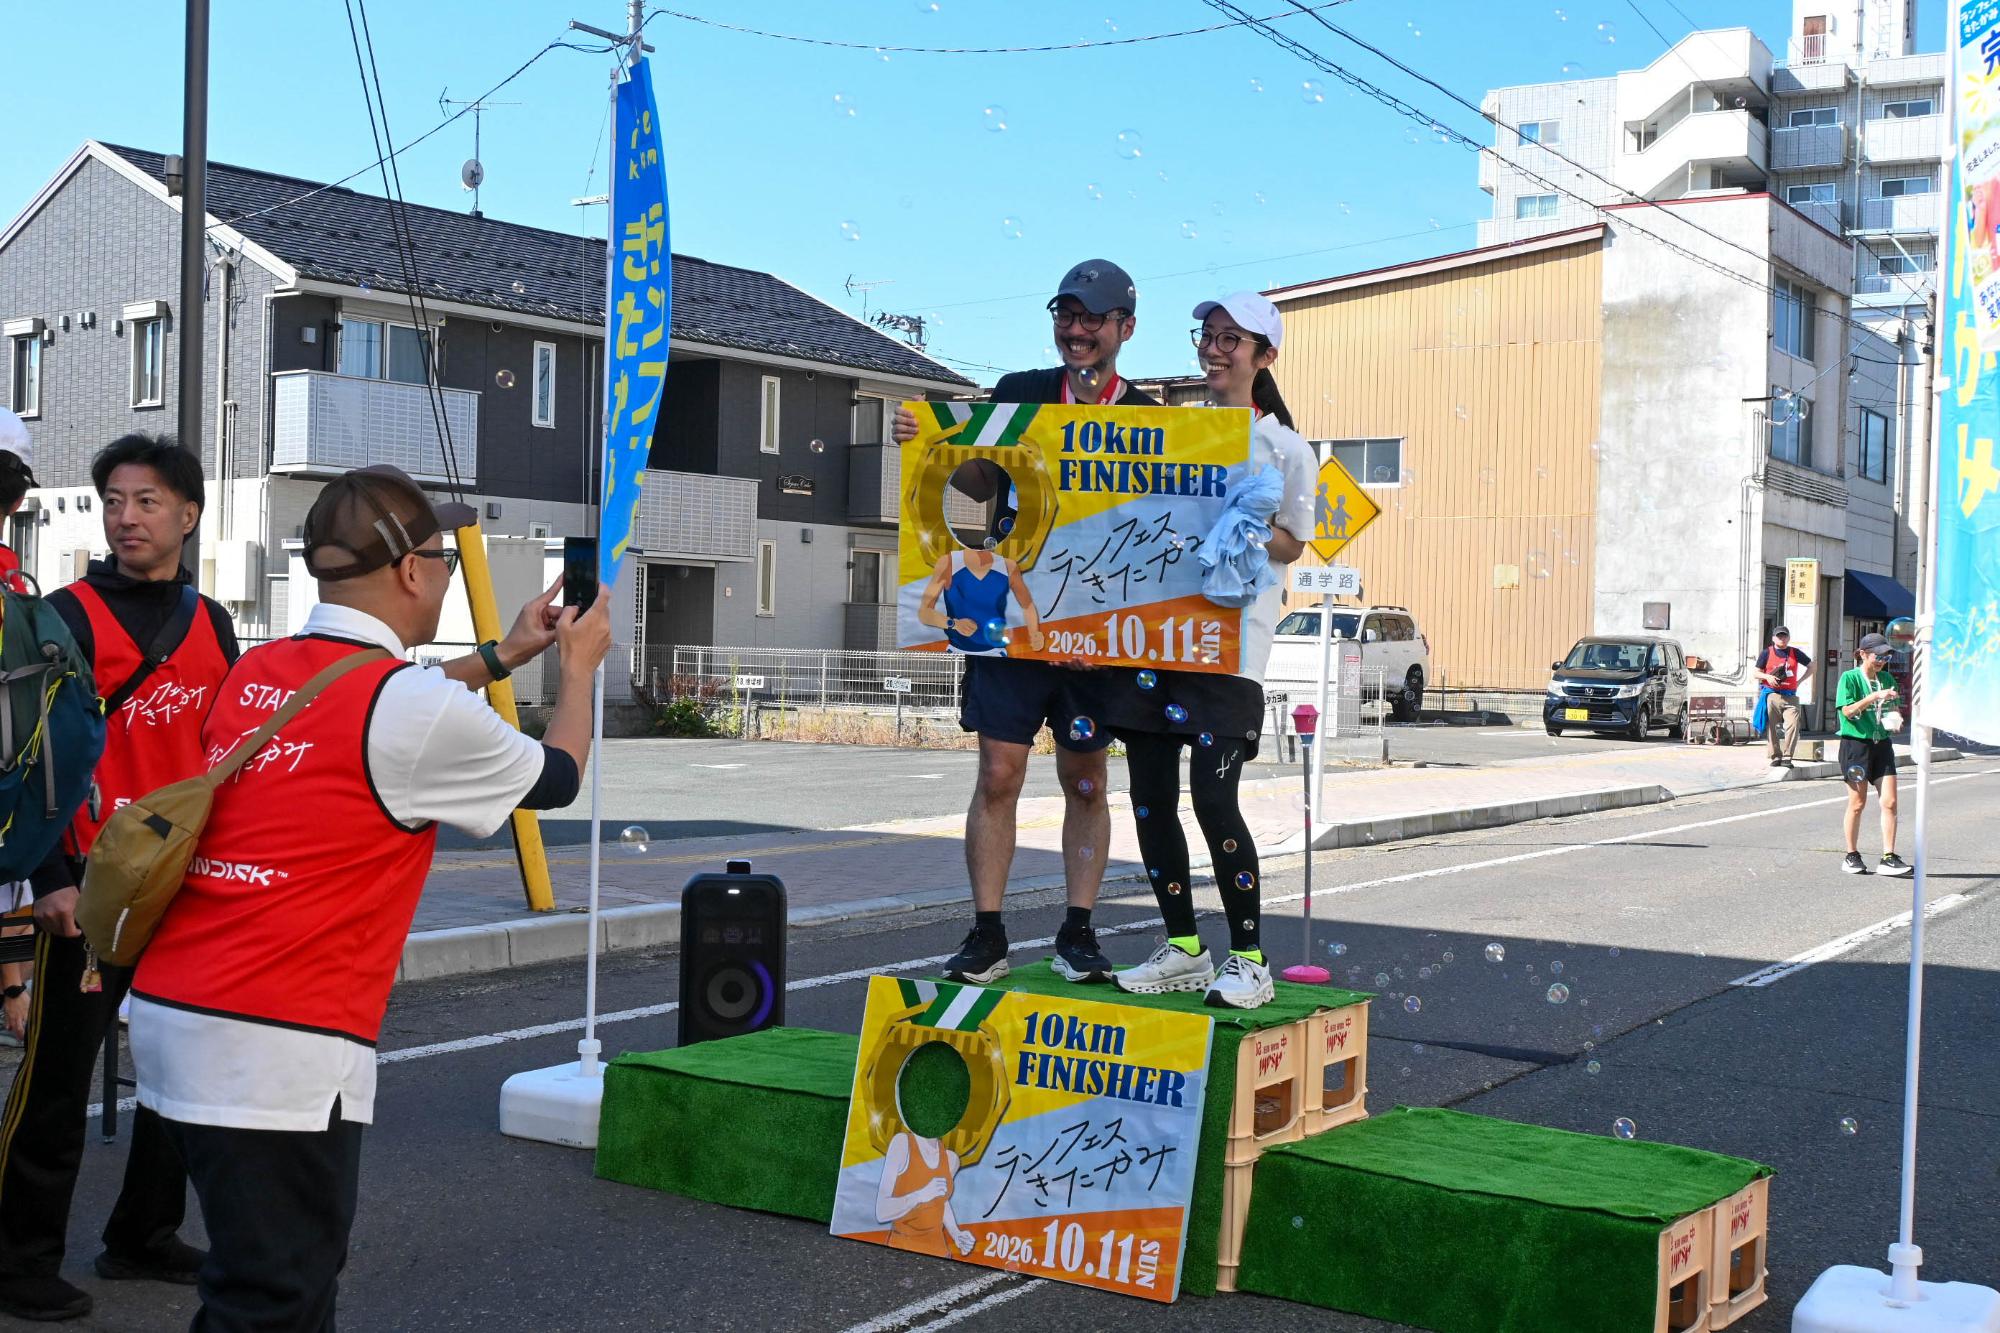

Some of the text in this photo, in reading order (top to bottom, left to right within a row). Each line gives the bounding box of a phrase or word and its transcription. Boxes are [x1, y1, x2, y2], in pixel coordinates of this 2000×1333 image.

[1060, 420, 1164, 456] 10km
[1058, 459, 1228, 498] FINISHER
[1298, 572, 1353, 588] 通学路
[1200, 619, 1221, 665] SUN
[1022, 1011, 1126, 1057] 10km
[1327, 1031, 1347, 1055] Asahi
[1015, 1050, 1186, 1108] FINISHER
[1259, 1052, 1282, 1077] Asahi
[983, 1118, 1127, 1218] ランフェス
[1026, 1144, 1177, 1208] きたかみ
[1731, 1210, 1749, 1239] Asahi
[1135, 1239, 1160, 1290] SUN
[1671, 1244, 1691, 1276] Asahi
